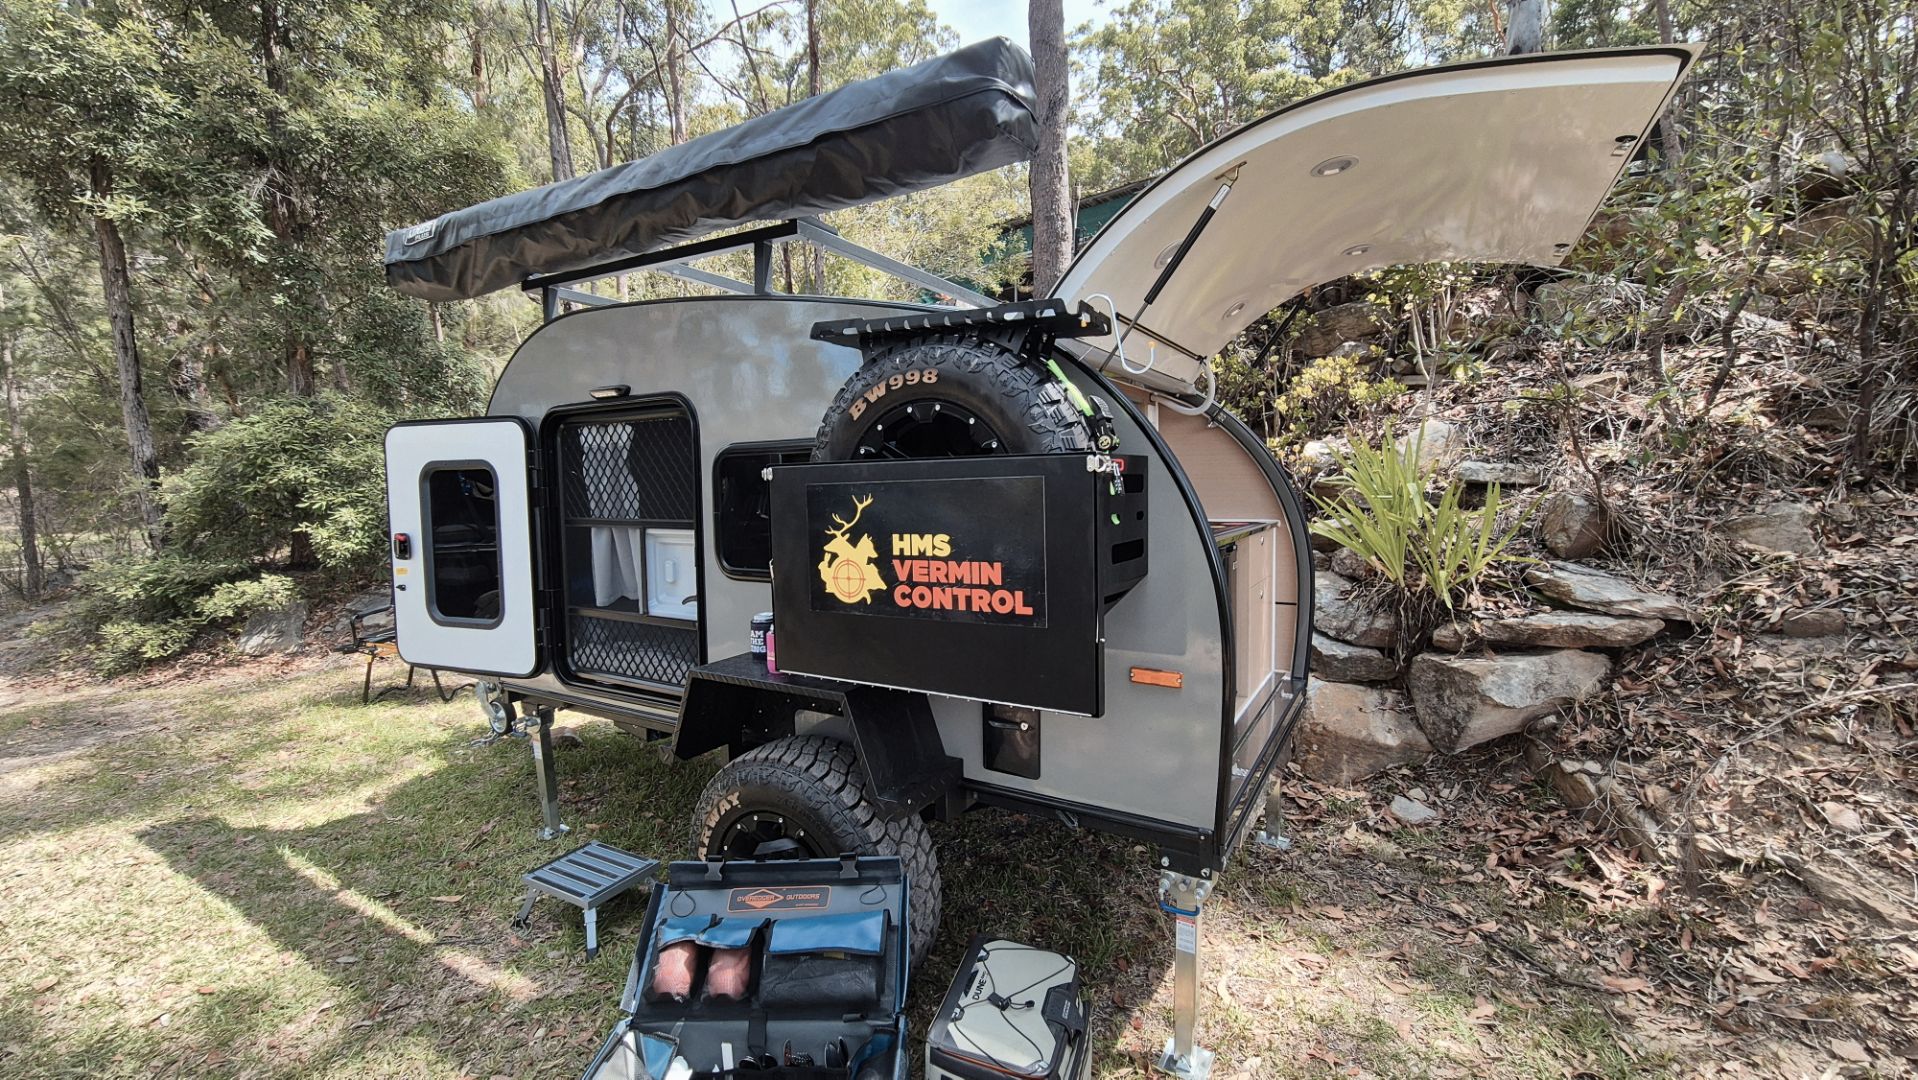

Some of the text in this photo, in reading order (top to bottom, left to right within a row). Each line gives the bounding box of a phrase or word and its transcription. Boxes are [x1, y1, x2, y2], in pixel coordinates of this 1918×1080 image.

[848, 367, 939, 421] BW998
[892, 533, 952, 557] HMS
[892, 559, 1002, 586] VERMIN
[893, 584, 1034, 615] CONTROL
[972, 979, 987, 1001] DUNE
